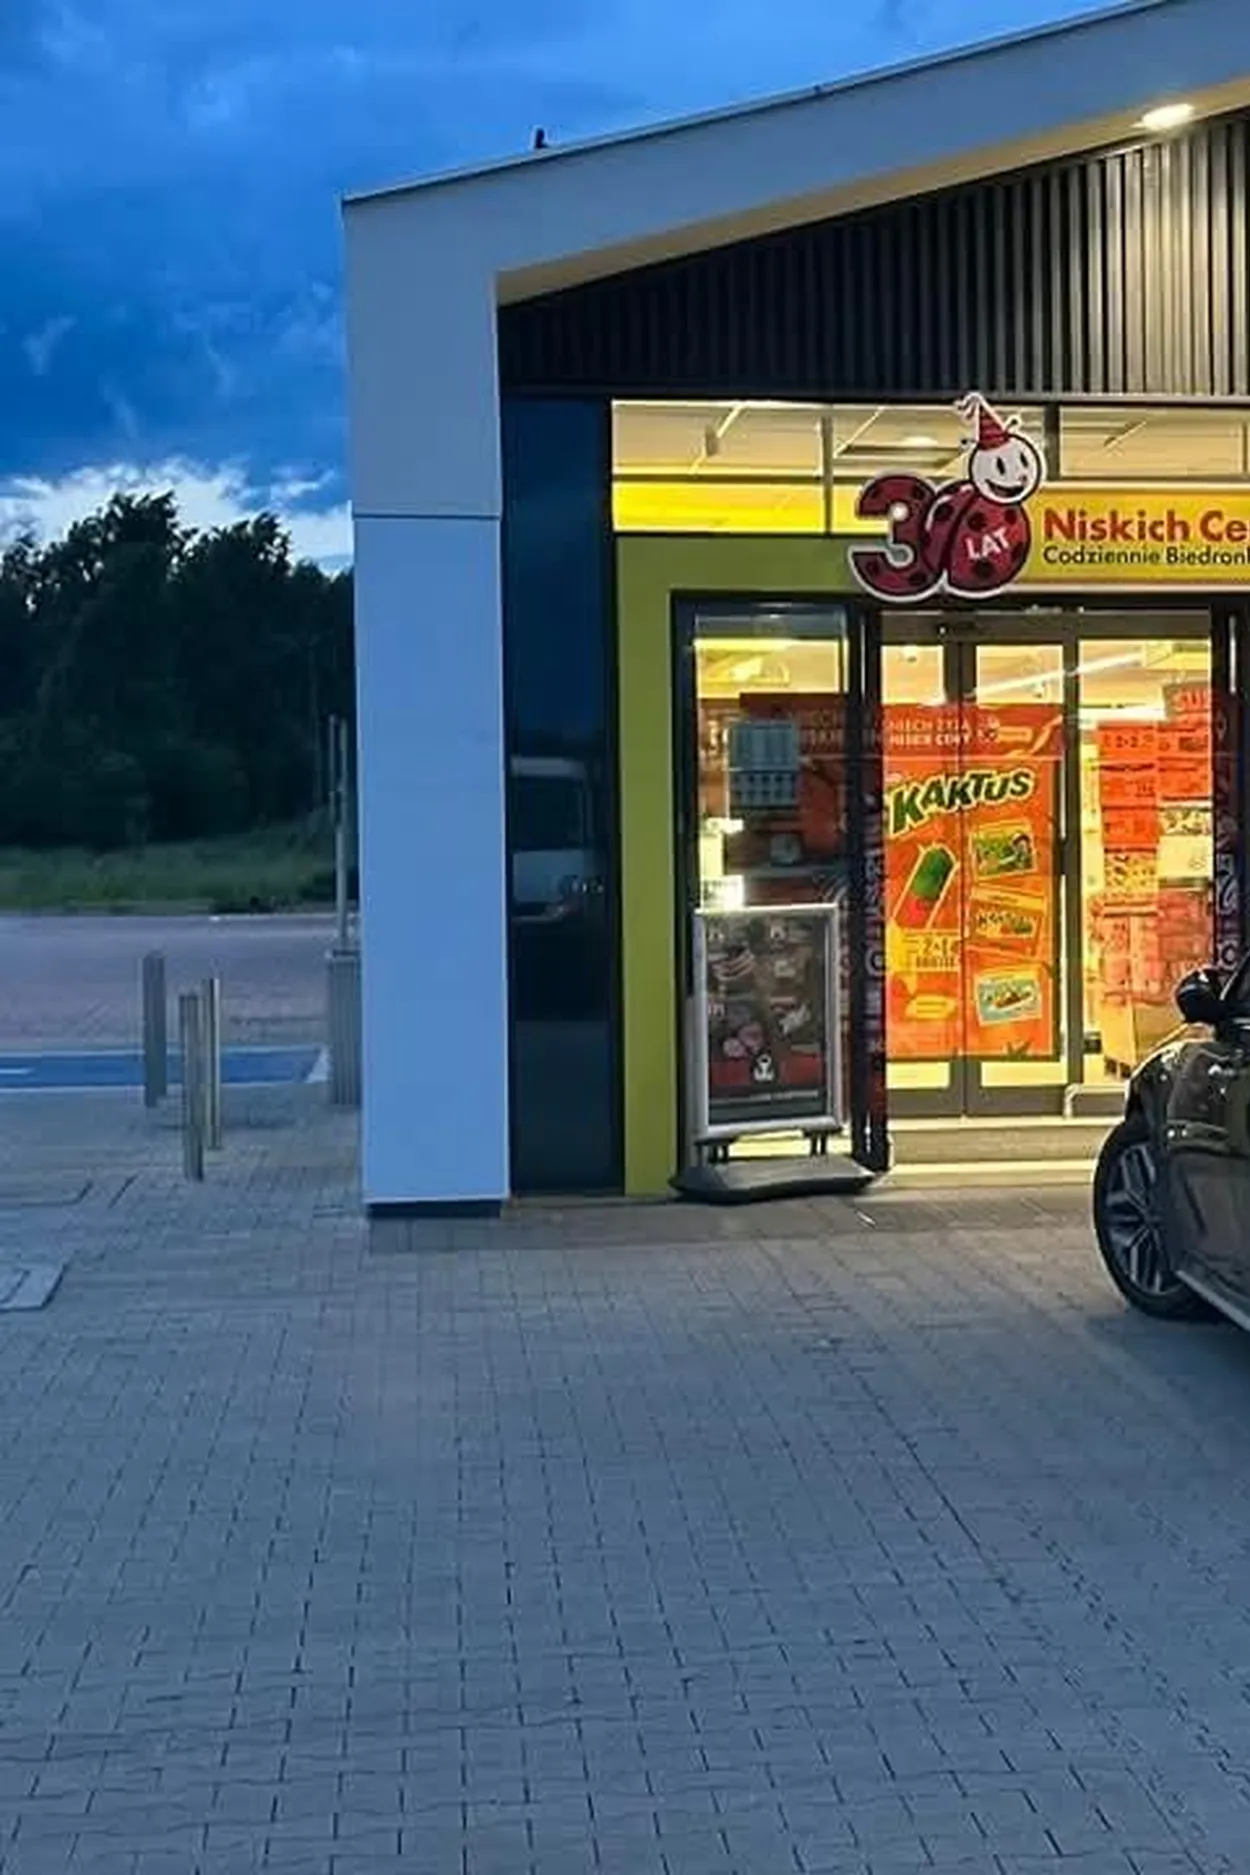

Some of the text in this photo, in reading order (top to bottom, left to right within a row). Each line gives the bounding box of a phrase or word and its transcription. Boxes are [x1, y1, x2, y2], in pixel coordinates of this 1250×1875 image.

[1043, 508, 1190, 542] Niskich
[964, 526, 1009, 561] LAT
[1043, 546, 1160, 566] Codziennie
[890, 770, 1034, 834] KAKTUS
